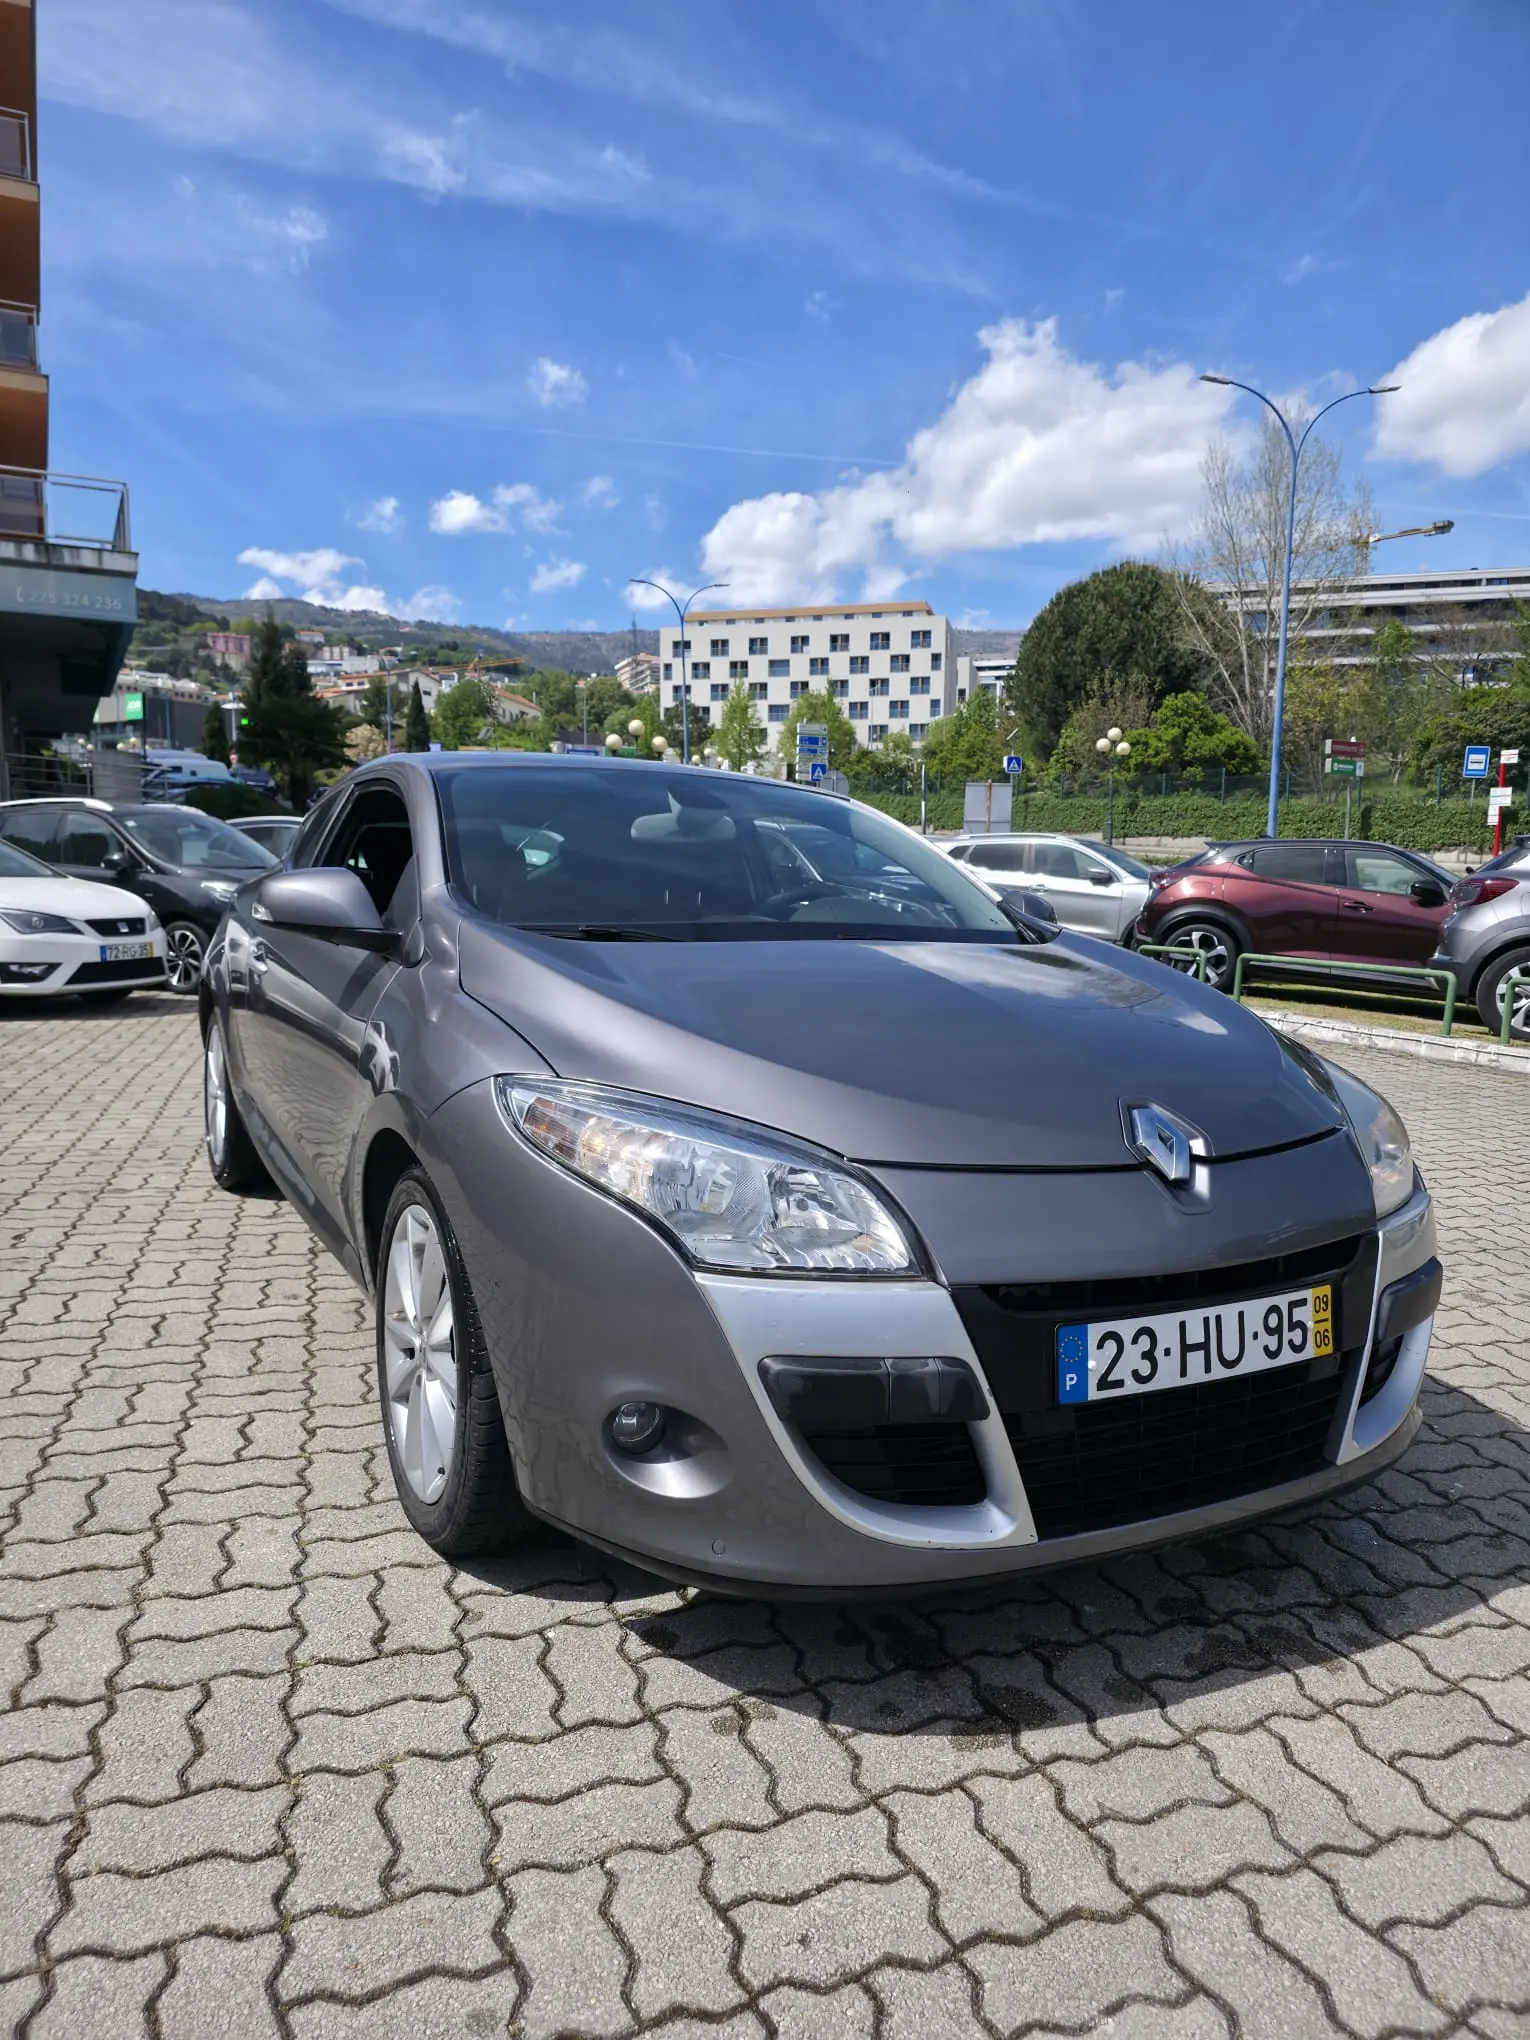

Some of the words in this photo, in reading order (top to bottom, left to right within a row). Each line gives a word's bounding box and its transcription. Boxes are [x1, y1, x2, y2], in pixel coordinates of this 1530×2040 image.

[94, 596, 122, 610] 236
[1313, 1293, 1330, 1315] 09
[1314, 1328, 1331, 1349] 06
[1065, 1373, 1078, 1391] P
